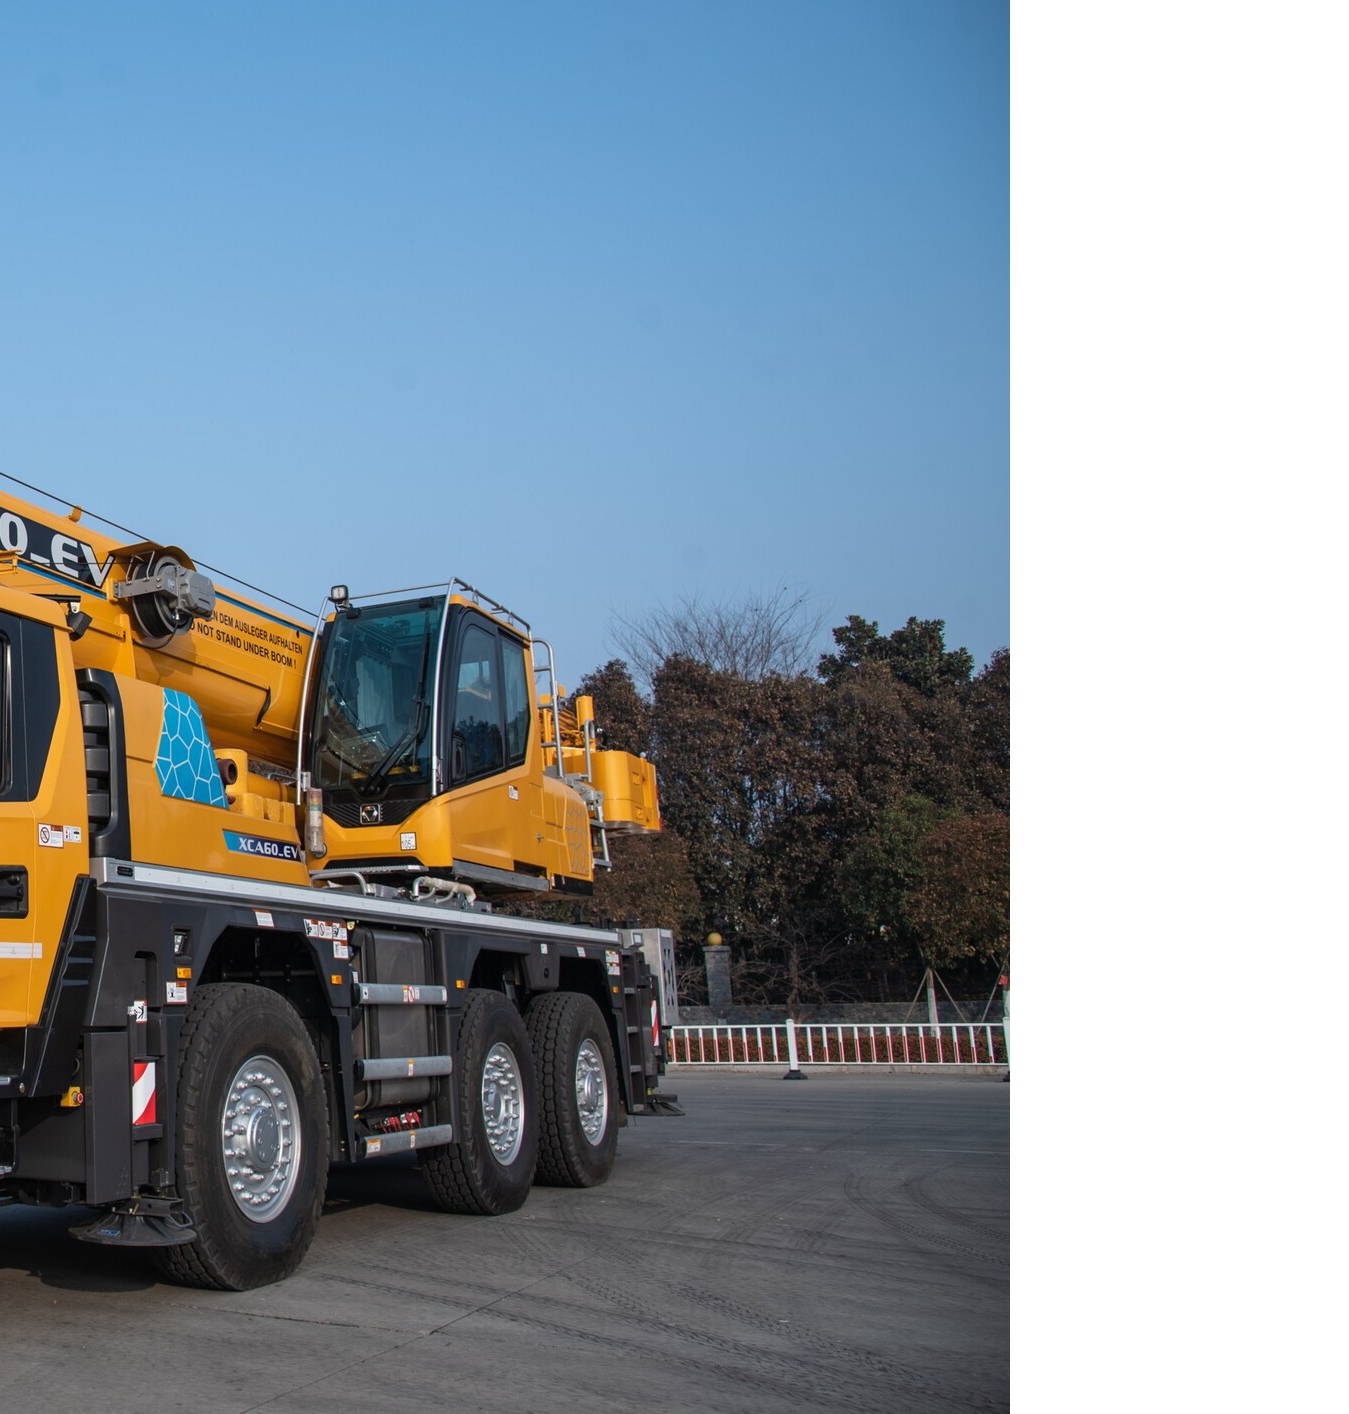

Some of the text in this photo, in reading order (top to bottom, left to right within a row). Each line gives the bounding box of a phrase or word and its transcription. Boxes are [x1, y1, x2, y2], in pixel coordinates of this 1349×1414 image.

[197, 622, 214, 638] NOT
[216, 629, 242, 649] STAND
[243, 640, 270, 659] UNDER
[271, 650, 293, 667] BOOM
[219, 612, 233, 628] DEM
[234, 619, 268, 641] AUSLEGER
[267, 634, 303, 655] AUFHALTEN
[238, 837, 298, 859] XCA60_EV
